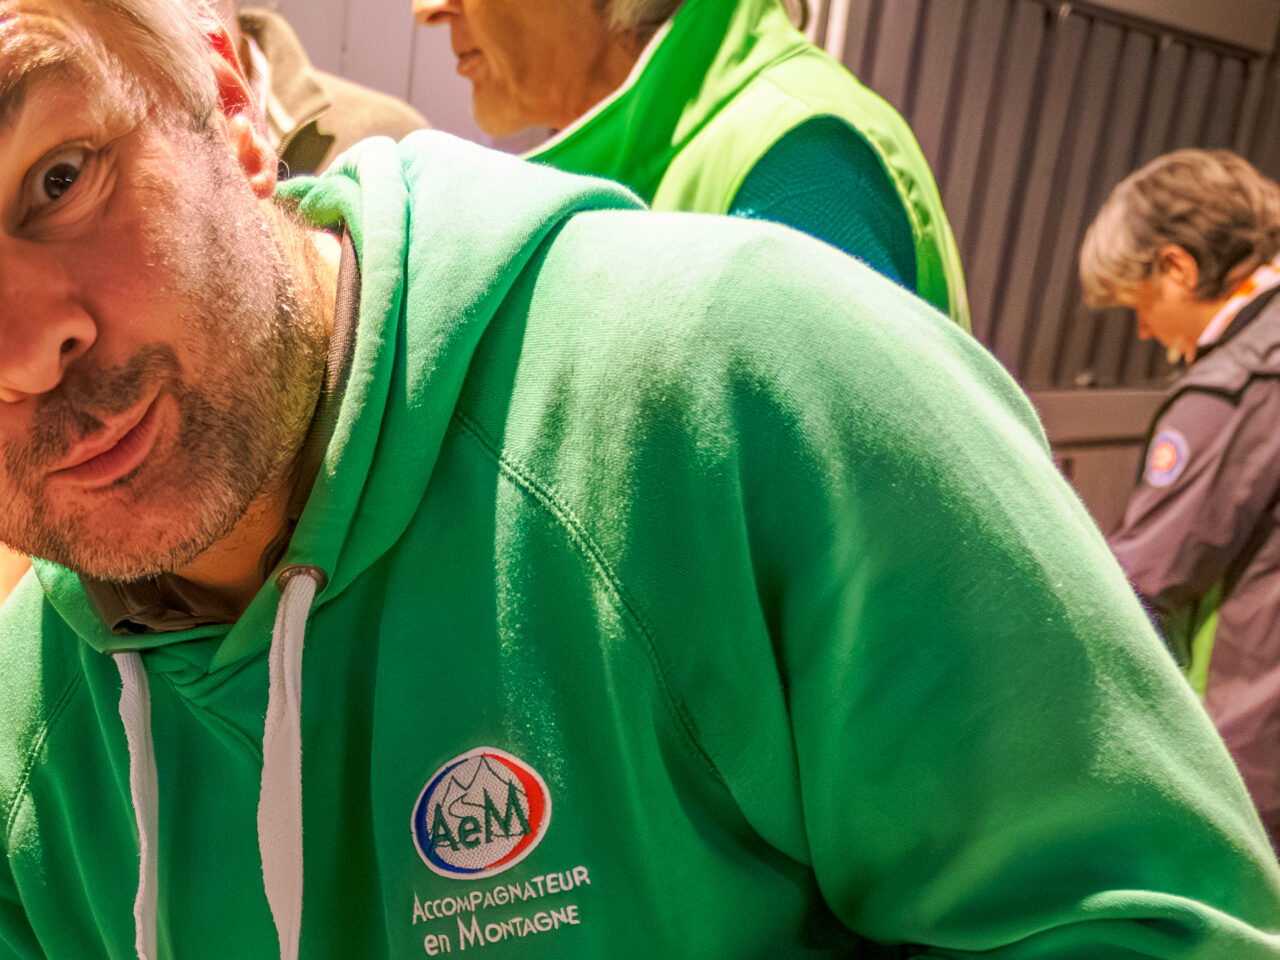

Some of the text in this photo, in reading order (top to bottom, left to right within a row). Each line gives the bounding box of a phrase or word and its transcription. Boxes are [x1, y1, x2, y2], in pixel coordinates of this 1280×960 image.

[428, 780, 532, 855] AeM
[412, 866, 591, 925] ACCOMPAGNATEUR
[424, 904, 581, 956] en MONTAGNE
